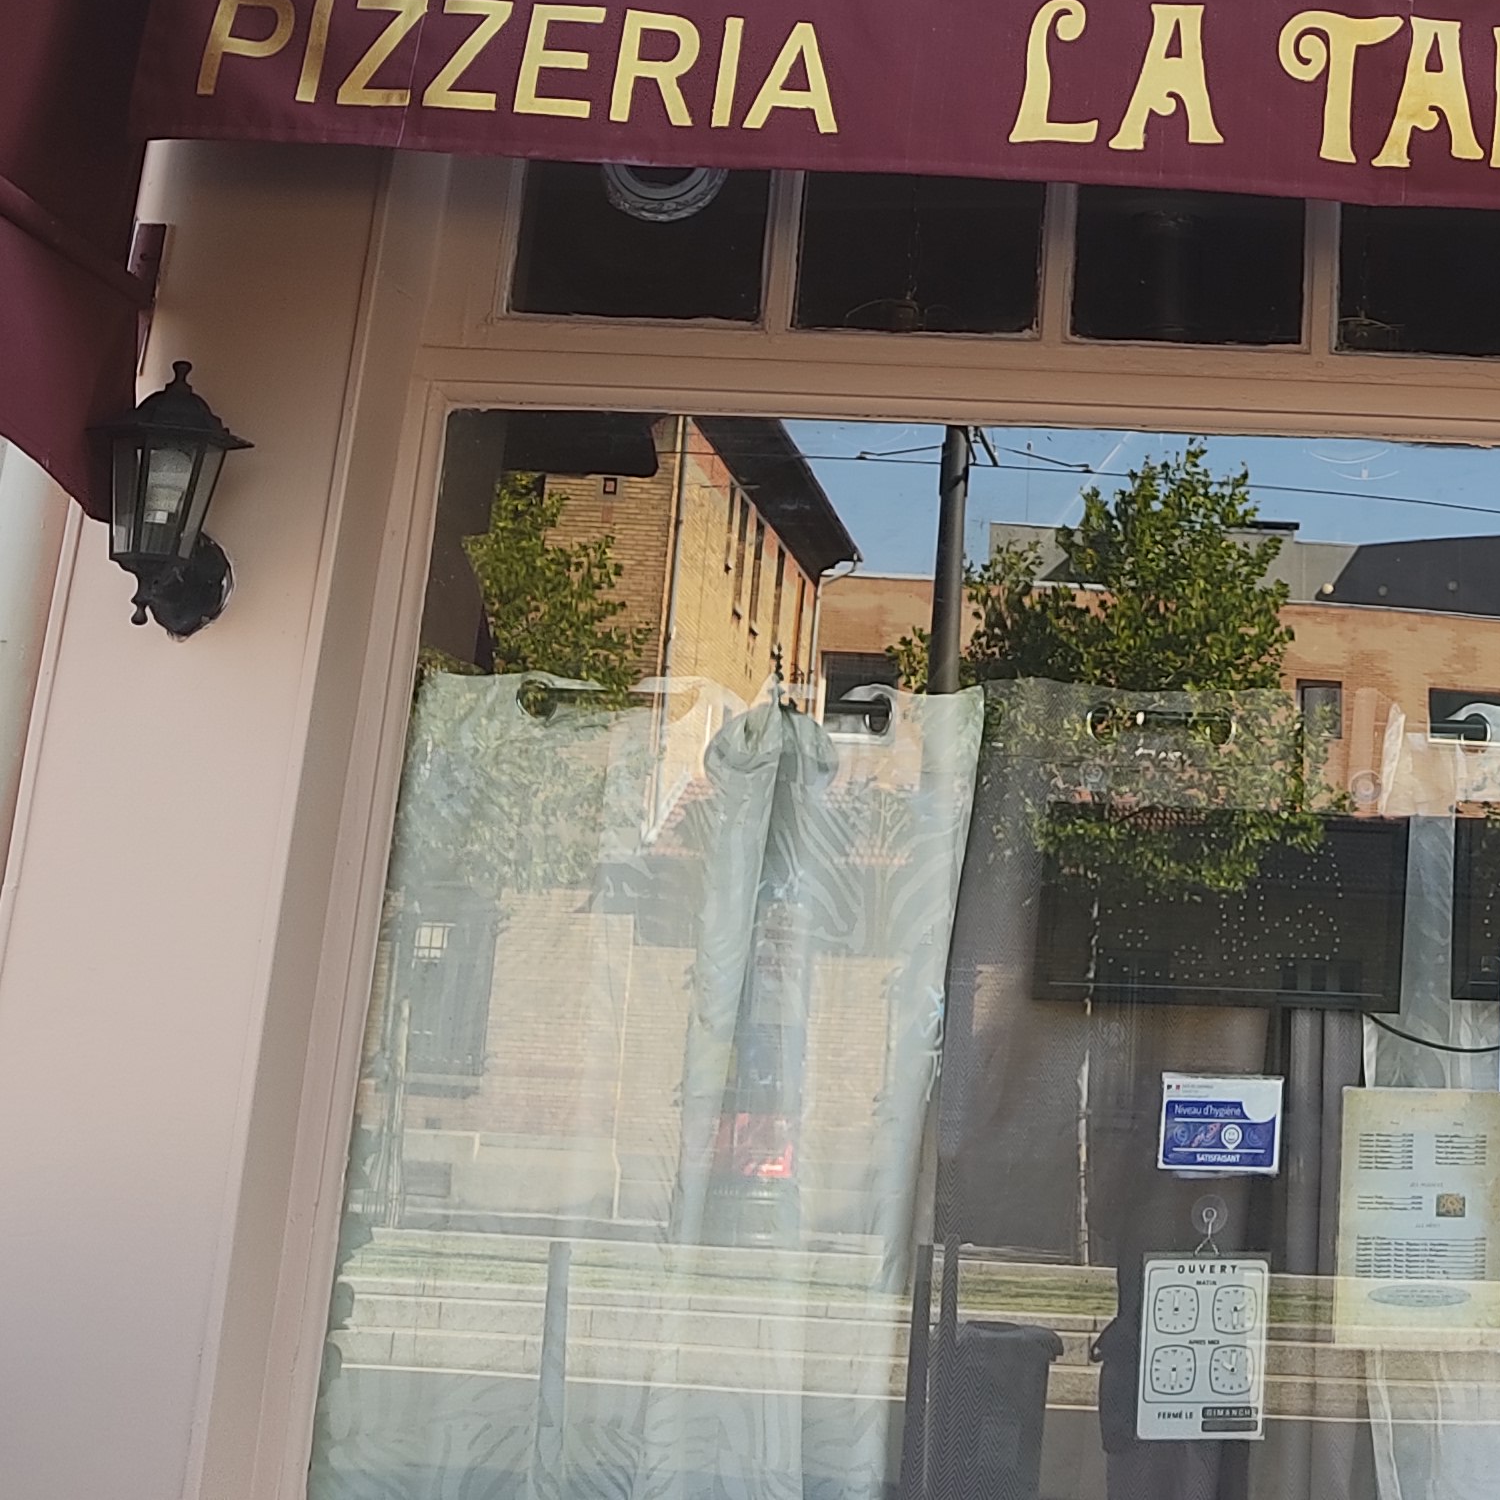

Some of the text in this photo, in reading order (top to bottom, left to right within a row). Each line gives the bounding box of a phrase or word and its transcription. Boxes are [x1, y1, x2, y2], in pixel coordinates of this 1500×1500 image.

[1174, 1104, 1201, 1115] Niveau
[1177, 1264, 1238, 1275] OUVERT
[1185, 1411, 1194, 1419] LE
